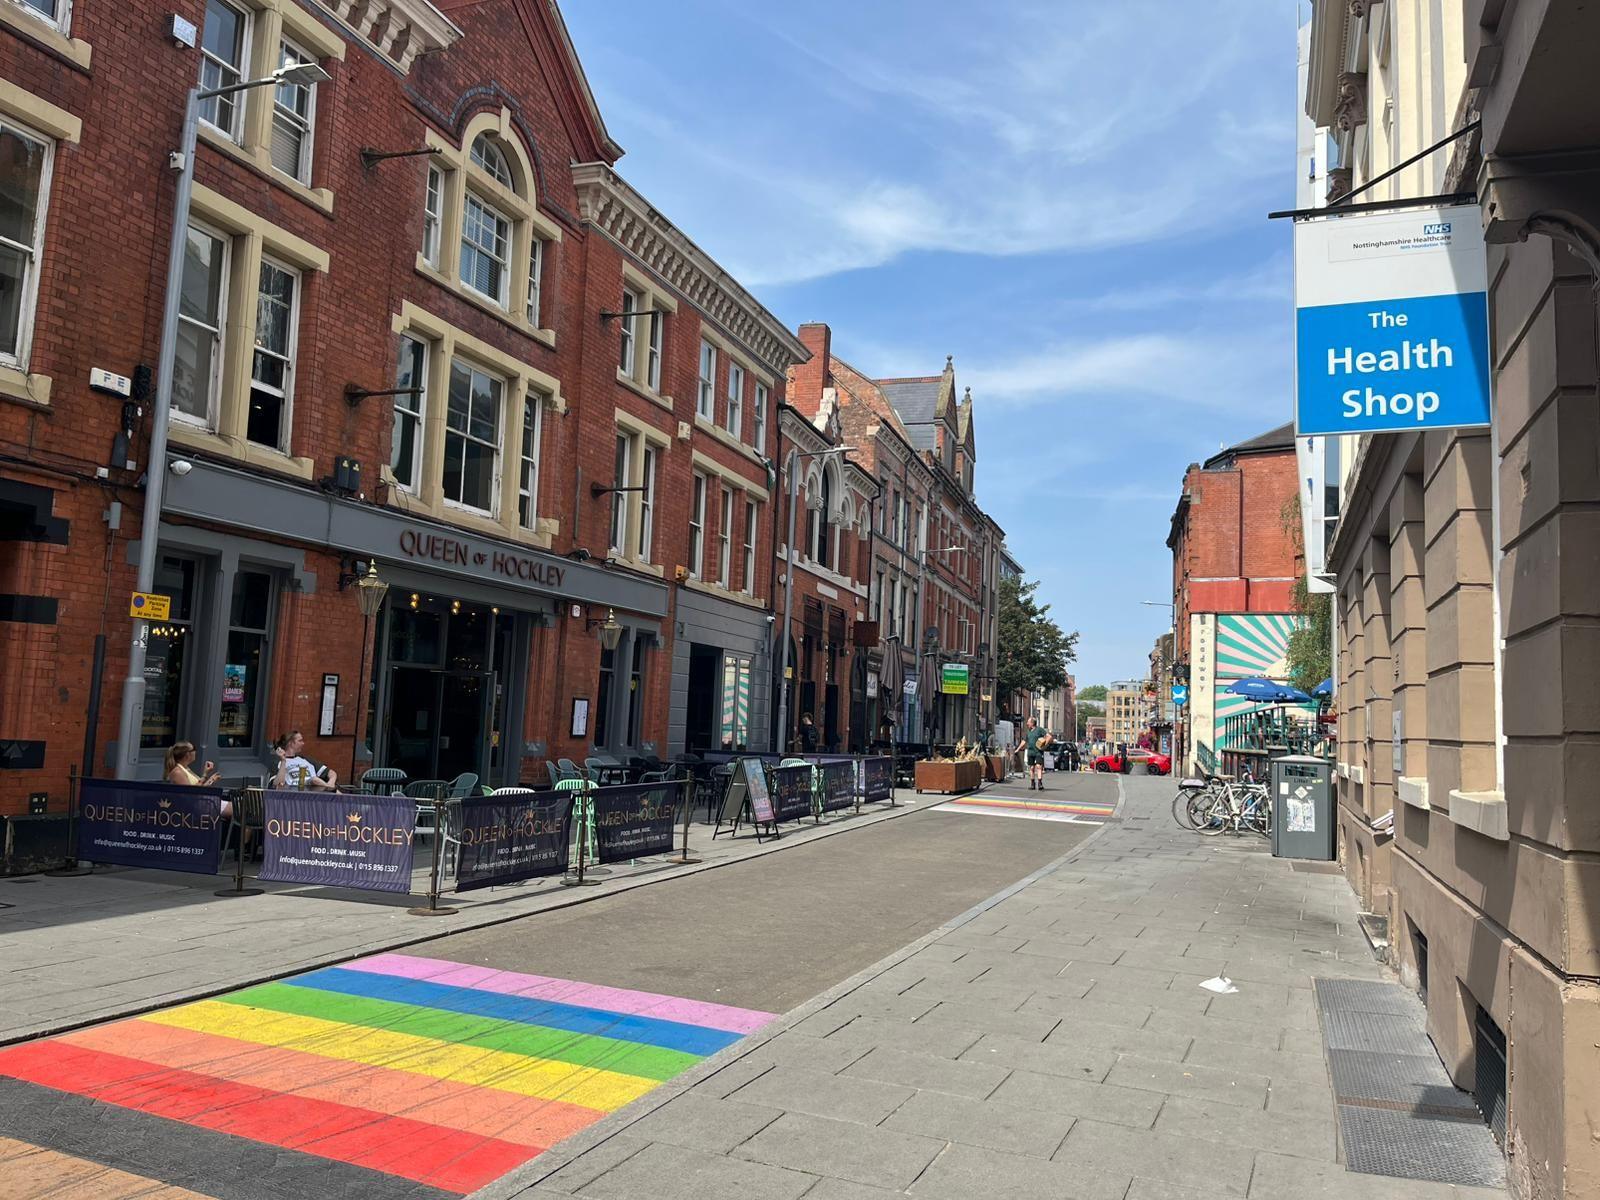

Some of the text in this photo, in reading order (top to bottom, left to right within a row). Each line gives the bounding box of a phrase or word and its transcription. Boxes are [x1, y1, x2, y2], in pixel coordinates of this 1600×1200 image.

[1425, 224, 1450, 234] NHS
[1353, 235, 1451, 249] Nottinghamshire Healthcare
[1368, 311, 1408, 328] The
[1327, 339, 1454, 375] Health
[1342, 387, 1440, 421] Shop
[400, 529, 566, 587] QUEEN OF HOCKLEY
[85, 804, 220, 830] QUEEN OF HOCKLEY
[598, 810, 629, 826] UEEN
[267, 819, 414, 846] QUEEN OF HOCKLEY
[462, 825, 506, 846] QUEEN
[515, 816, 567, 838] HOCKLEY
[330, 848, 347, 856] DRINK
[349, 849, 366, 857] MUSIC
[384, 865, 398, 873] 1337
